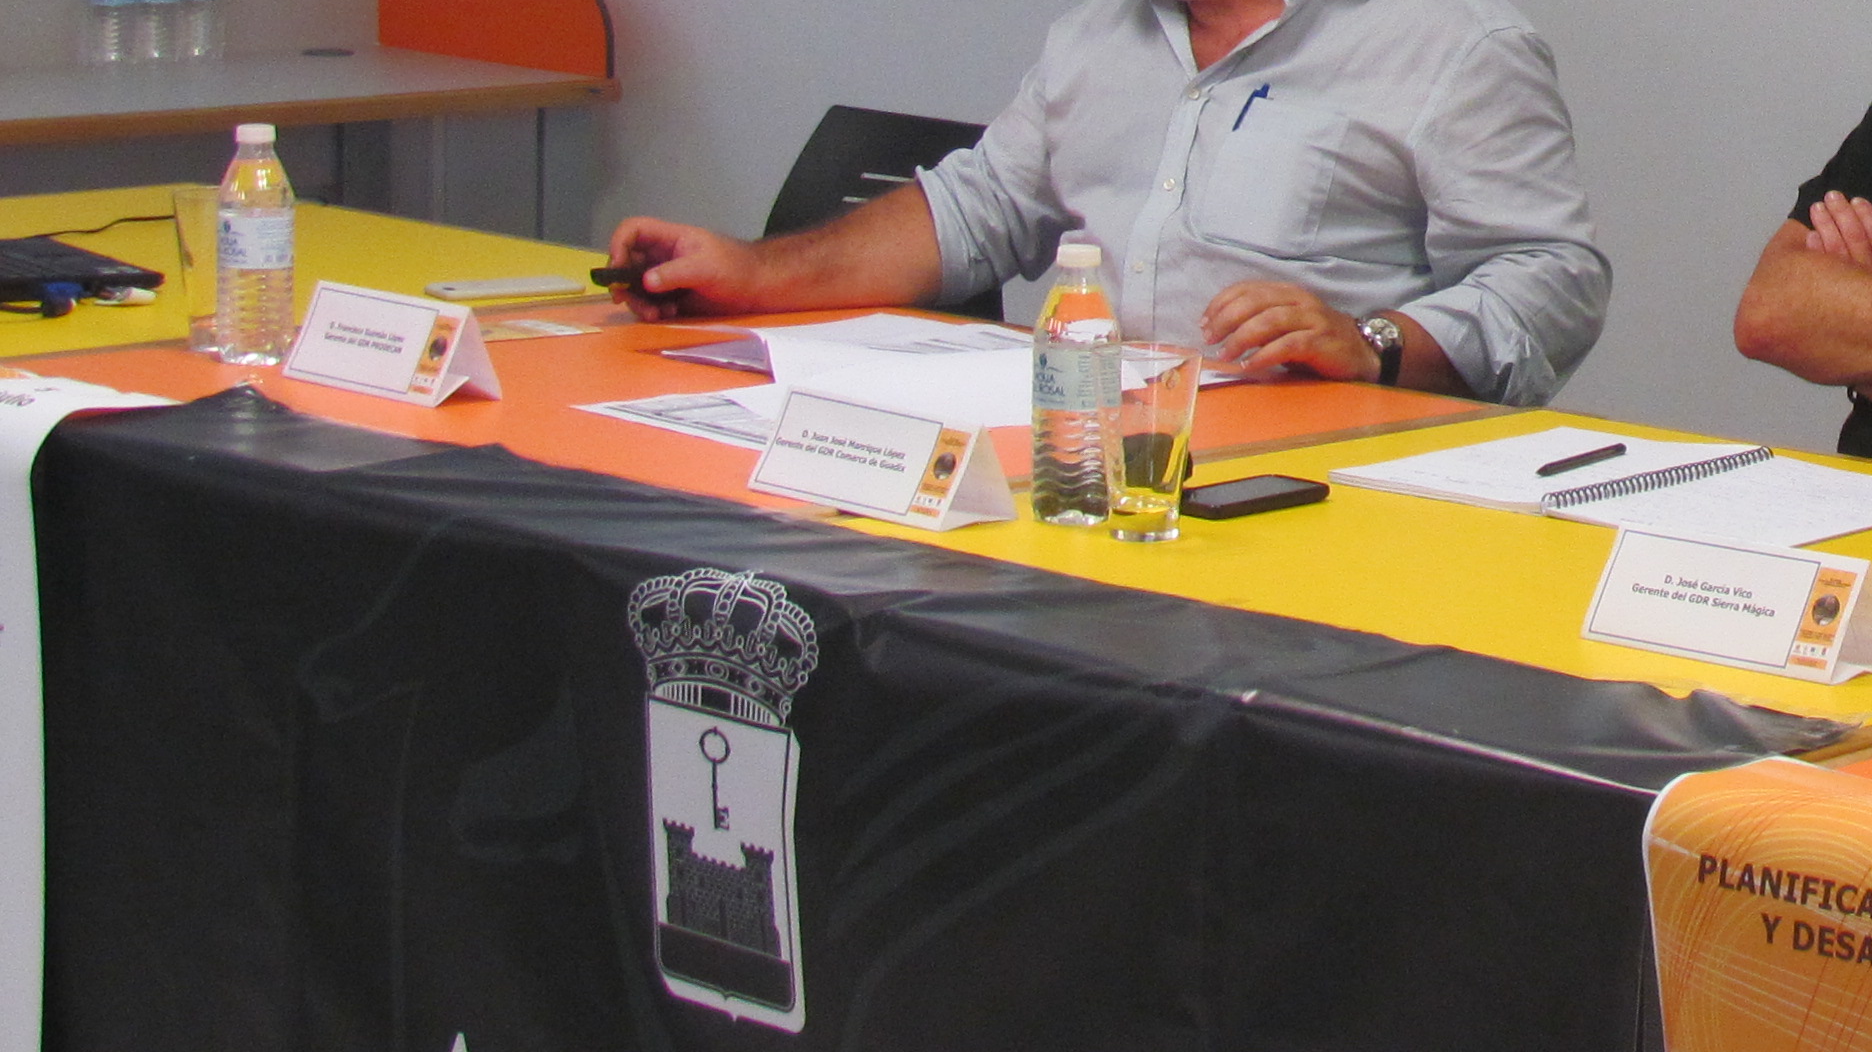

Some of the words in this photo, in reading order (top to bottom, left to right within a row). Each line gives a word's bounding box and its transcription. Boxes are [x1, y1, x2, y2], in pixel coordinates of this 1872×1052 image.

[0, 390, 36, 407] ulio
[775, 437, 804, 450] Gerente
[805, 443, 817, 453] del
[818, 446, 835, 457] GDR
[835, 450, 868, 465] Comarca
[868, 457, 878, 467] de
[811, 431, 829, 443] Juan
[830, 435, 847, 447] José
[848, 440, 883, 455] Manrique
[883, 446, 906, 459] López
[1631, 582, 1670, 600] Gerente
[1671, 588, 1688, 603] del
[1688, 592, 1711, 608] GDR
[1711, 597, 1740, 613] Sierra
[1742, 600, 1776, 619] Mágica
[1664, 574, 1674, 586] D.
[1677, 575, 1699, 592] José
[1700, 579, 1731, 596] García
[1732, 586, 1753, 600] Vico
[1760, 912, 1781, 946] Y
